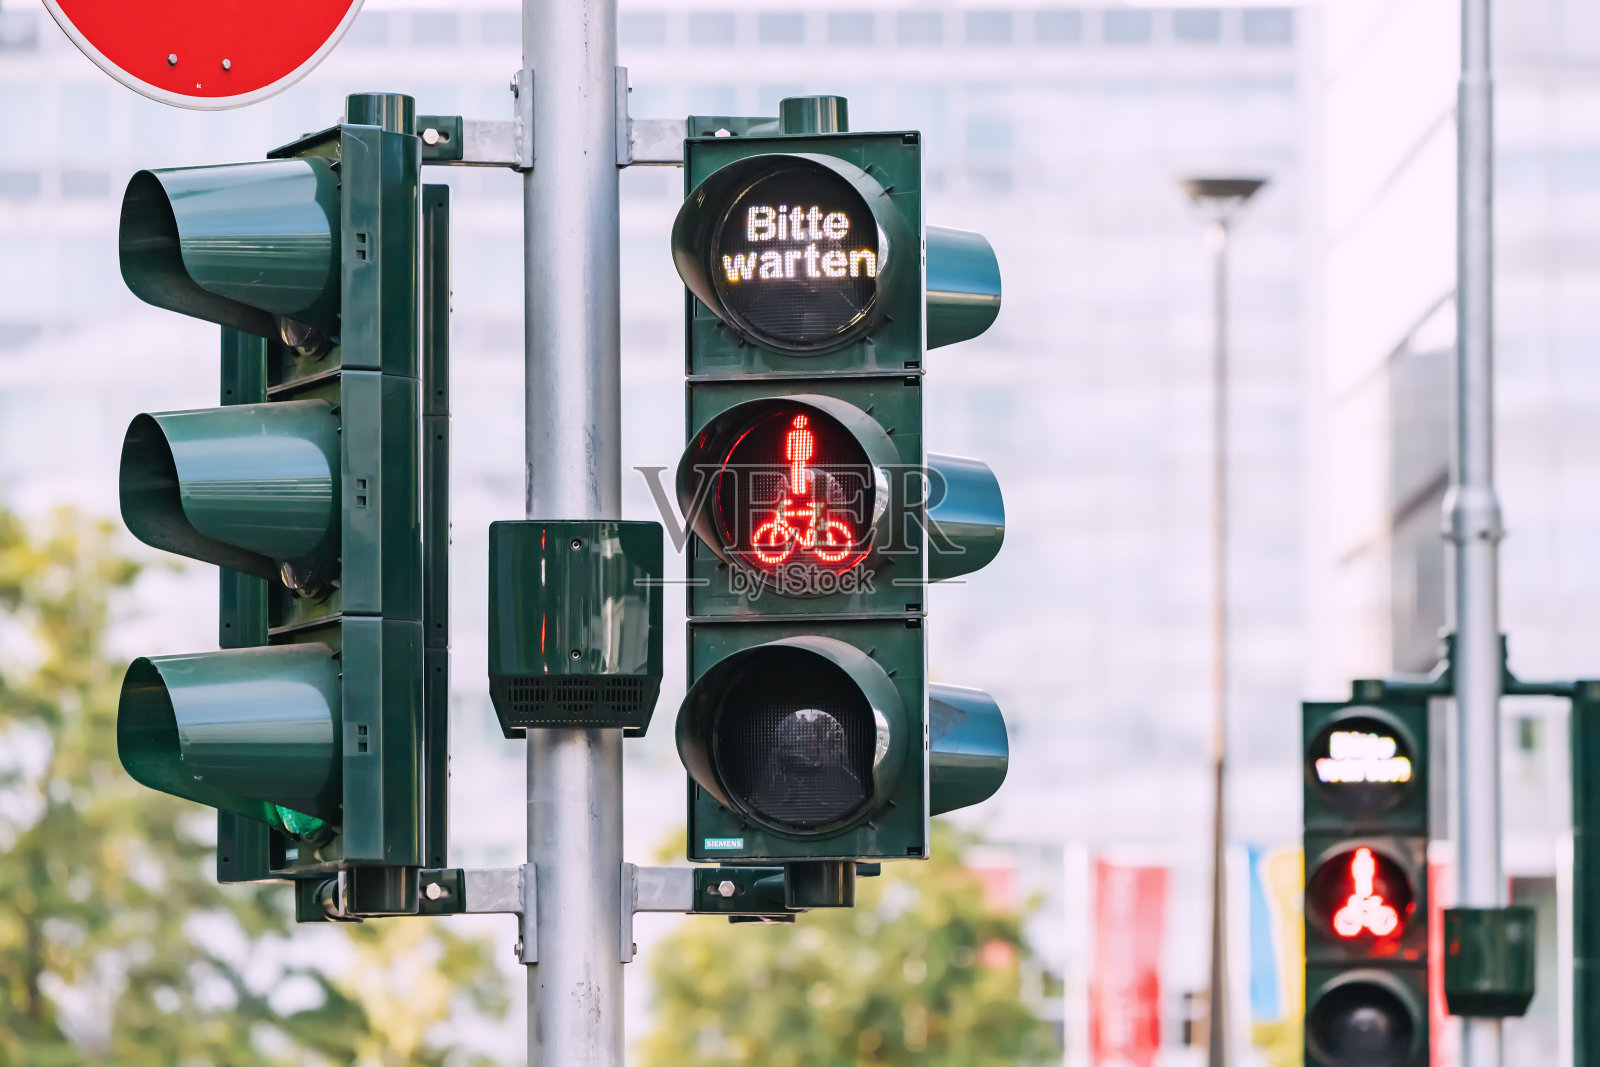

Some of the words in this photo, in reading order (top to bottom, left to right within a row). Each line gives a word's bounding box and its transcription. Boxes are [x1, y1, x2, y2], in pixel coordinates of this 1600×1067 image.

[746, 205, 850, 242] Bitte
[722, 243, 877, 282] warten
[706, 840, 742, 848] SIEMENS
